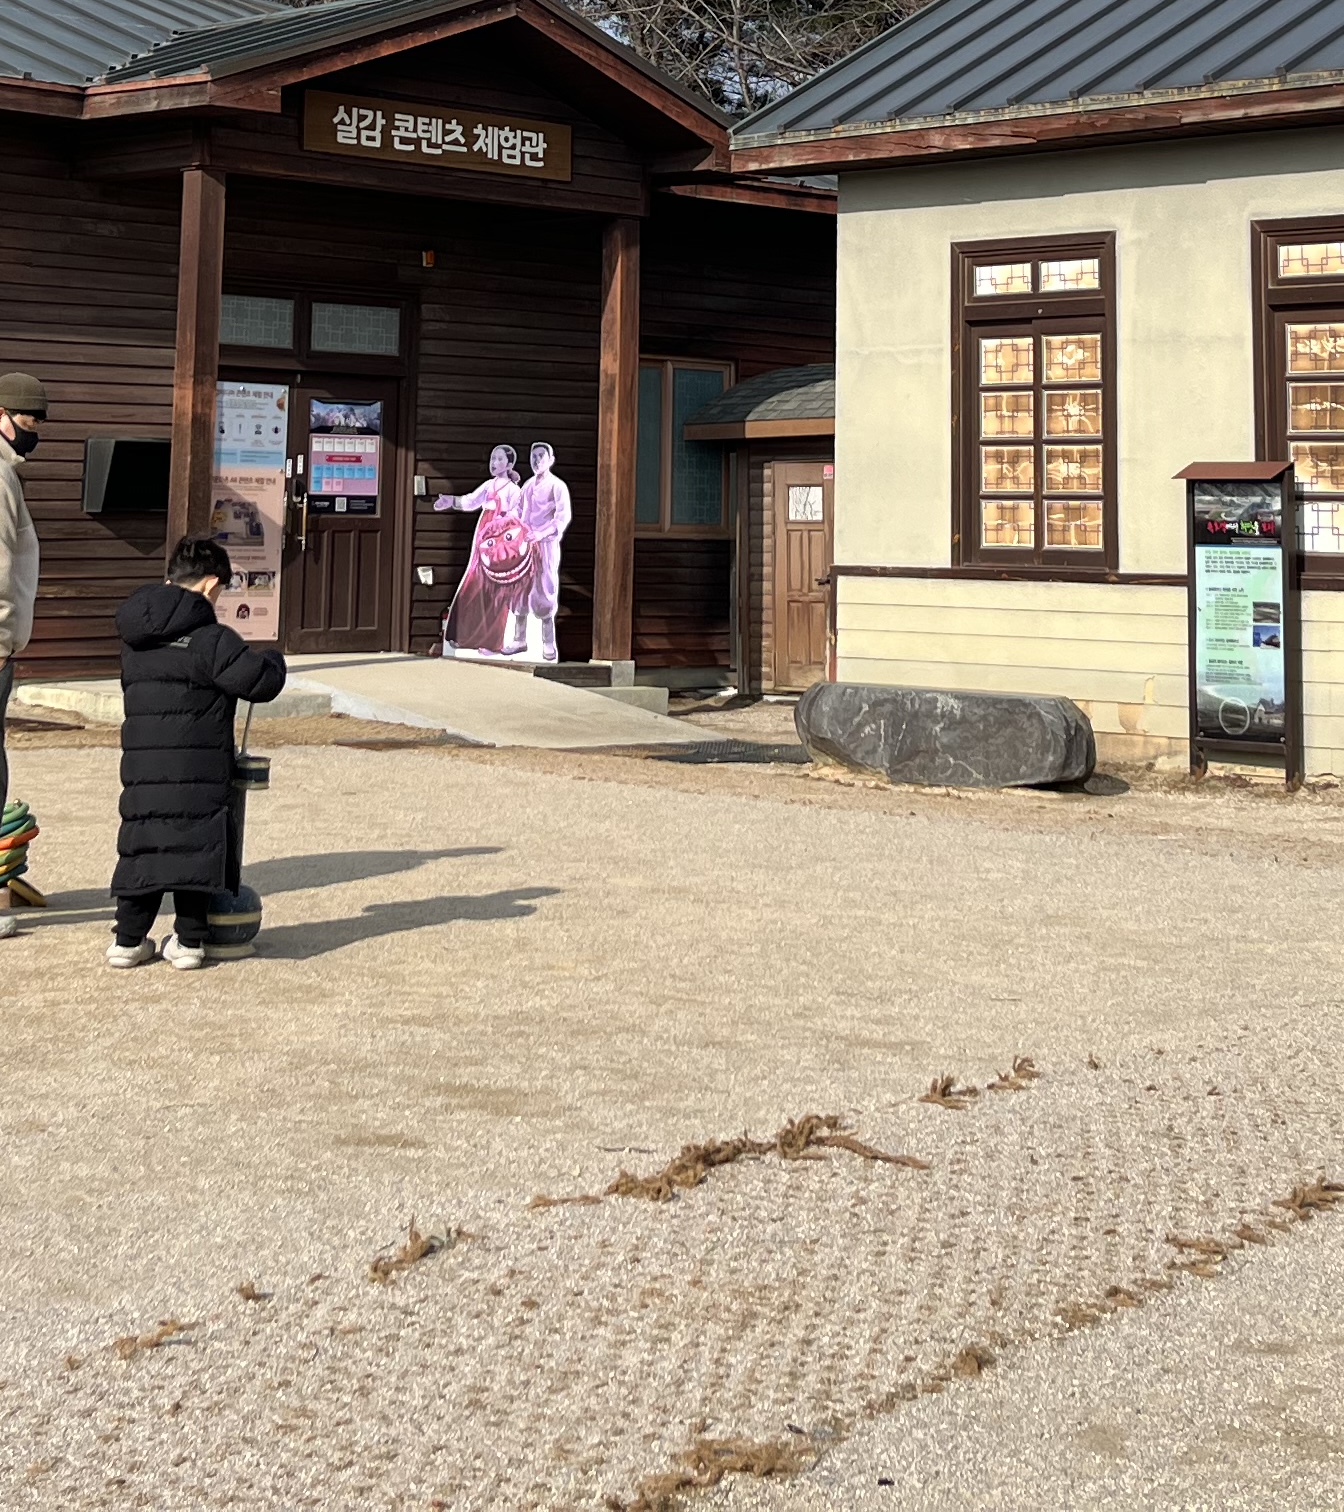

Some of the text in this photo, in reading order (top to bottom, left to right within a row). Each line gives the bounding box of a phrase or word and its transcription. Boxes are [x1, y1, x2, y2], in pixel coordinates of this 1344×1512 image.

[332, 105, 548, 167] 실감 콘텐츠 체험관
